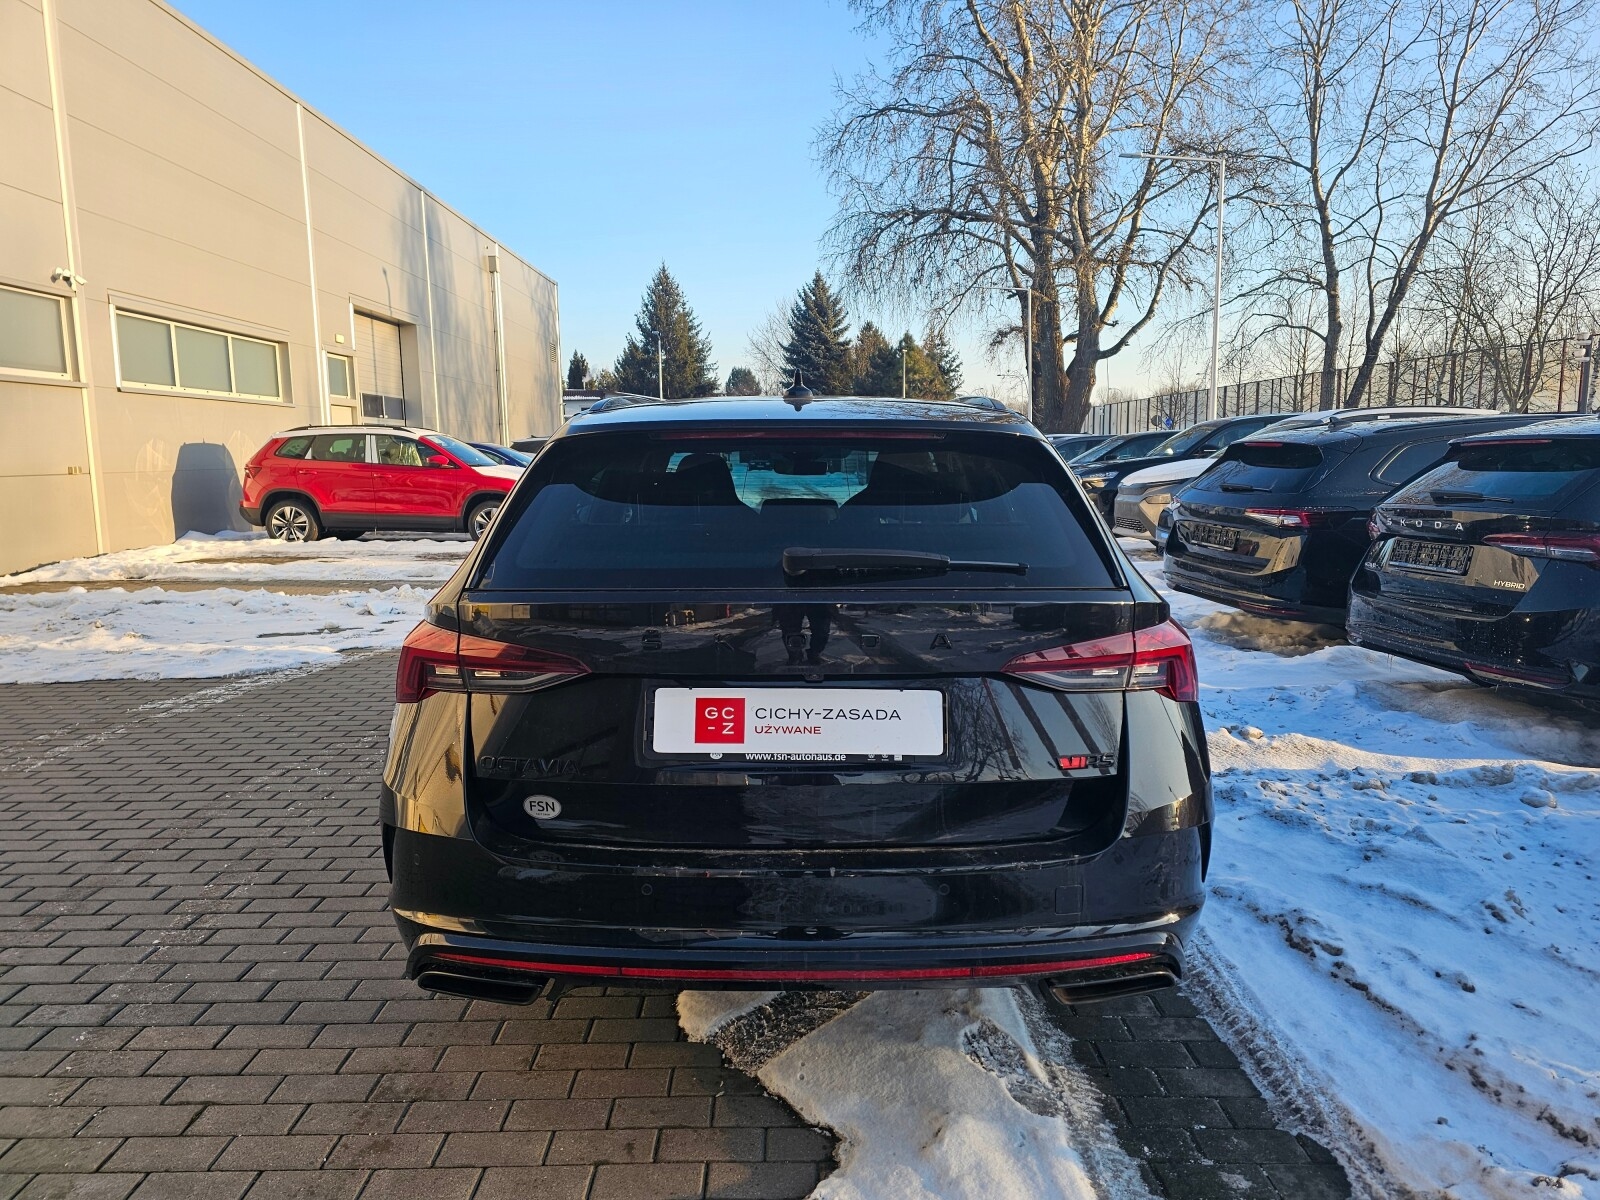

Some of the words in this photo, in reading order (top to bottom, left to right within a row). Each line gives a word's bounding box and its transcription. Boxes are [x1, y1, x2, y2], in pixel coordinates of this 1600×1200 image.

[1493, 580, 1526, 590] HYBRID
[705, 707, 735, 719] GC
[755, 707, 902, 721] CICHY-ZASADA
[754, 724, 821, 735] UŻYWANE
[745, 753, 847, 761] www.fsn-autohaus.de
[480, 756, 580, 774] OCTAVIA
[529, 801, 555, 812] FSN
